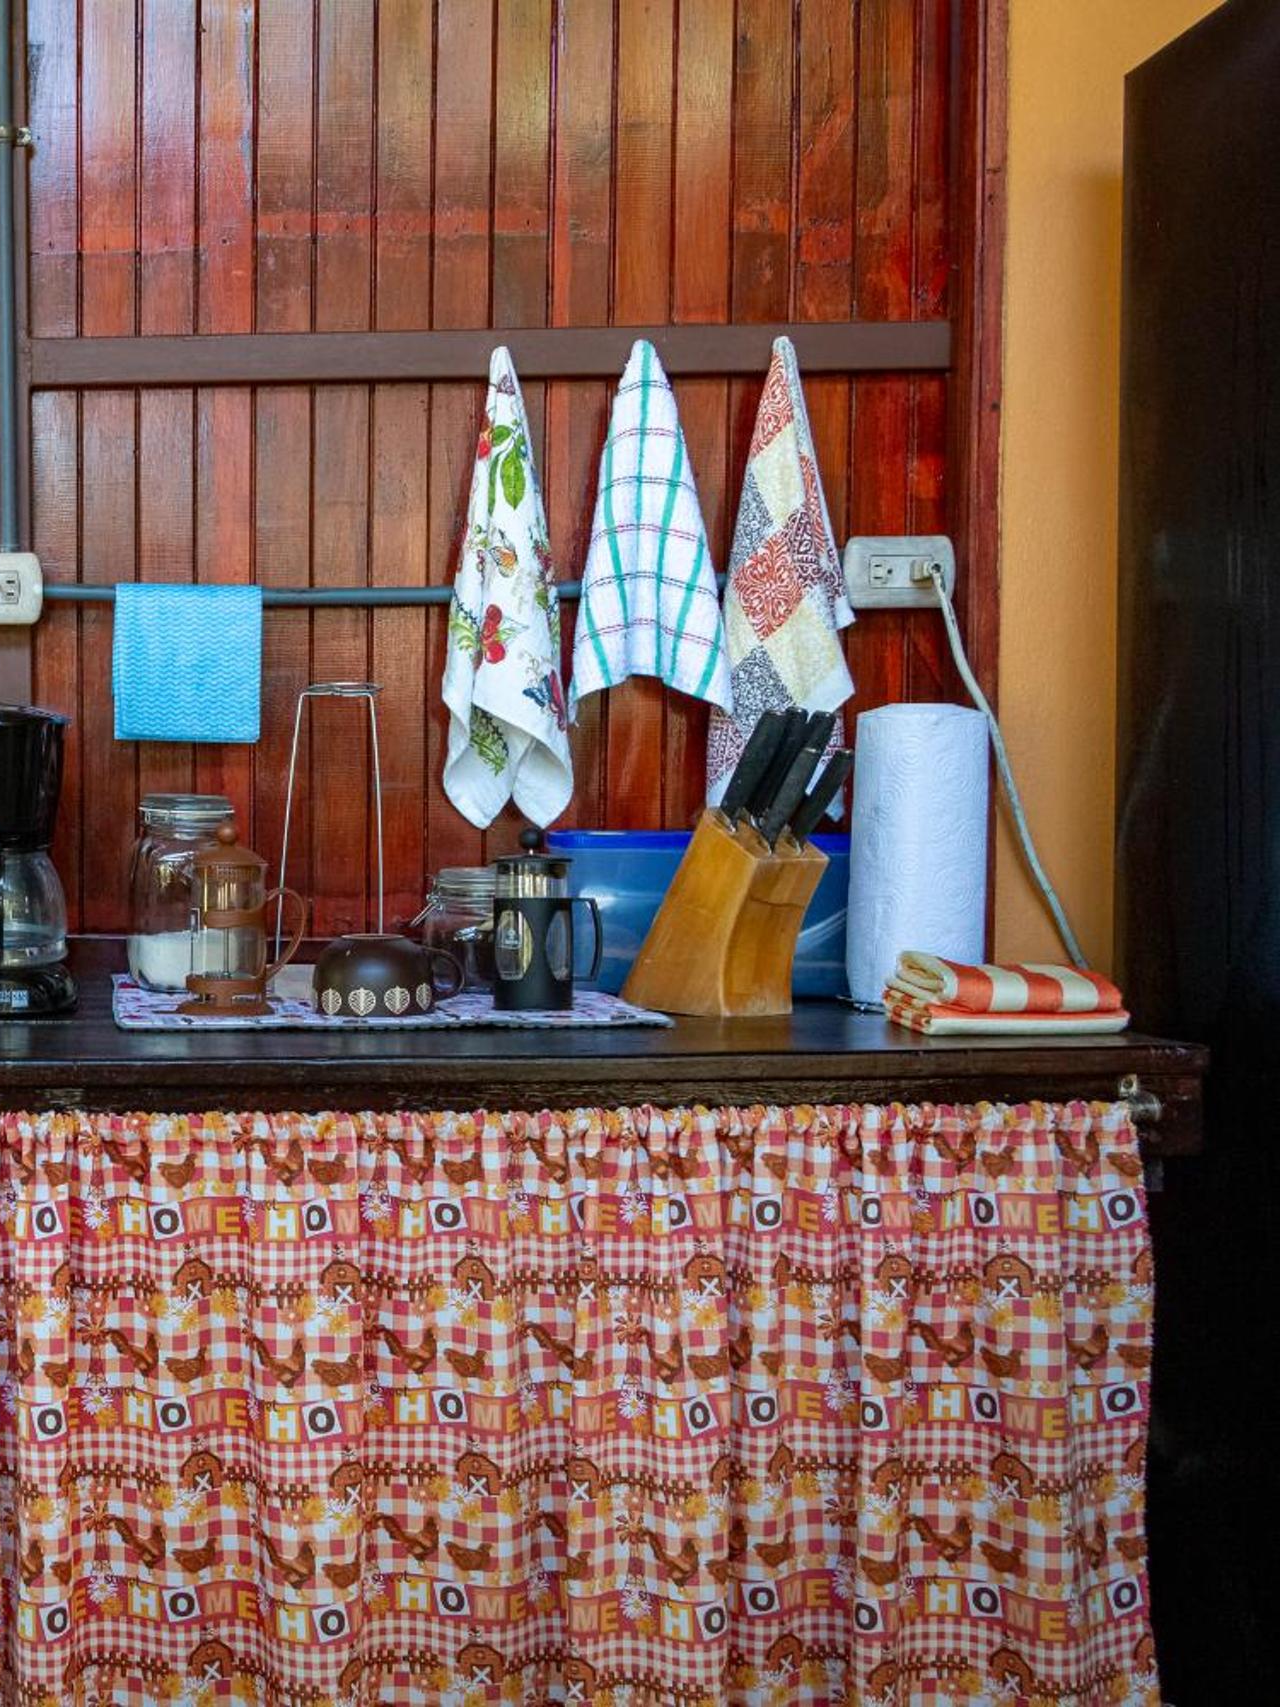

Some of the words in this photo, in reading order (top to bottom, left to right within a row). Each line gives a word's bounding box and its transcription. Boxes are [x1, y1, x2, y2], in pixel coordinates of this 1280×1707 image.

[121, 1203, 241, 1237] HOME
[269, 1205, 359, 1240] HOM
[653, 1199, 720, 1234] HOM
[1067, 1194, 1134, 1229] HO
[128, 1390, 249, 1430] HOME
[269, 1404, 362, 1441] HOM
[399, 1391, 520, 1433] HOME
[934, 1388, 1066, 1438] HOME
[1072, 1387, 1136, 1424] HO
[132, 1583, 258, 1620] HOME
[400, 1578, 526, 1620] HOME
[927, 1581, 1066, 1640] HOME
[1089, 1582, 1136, 1625] HO
[663, 1604, 725, 1640] HO
